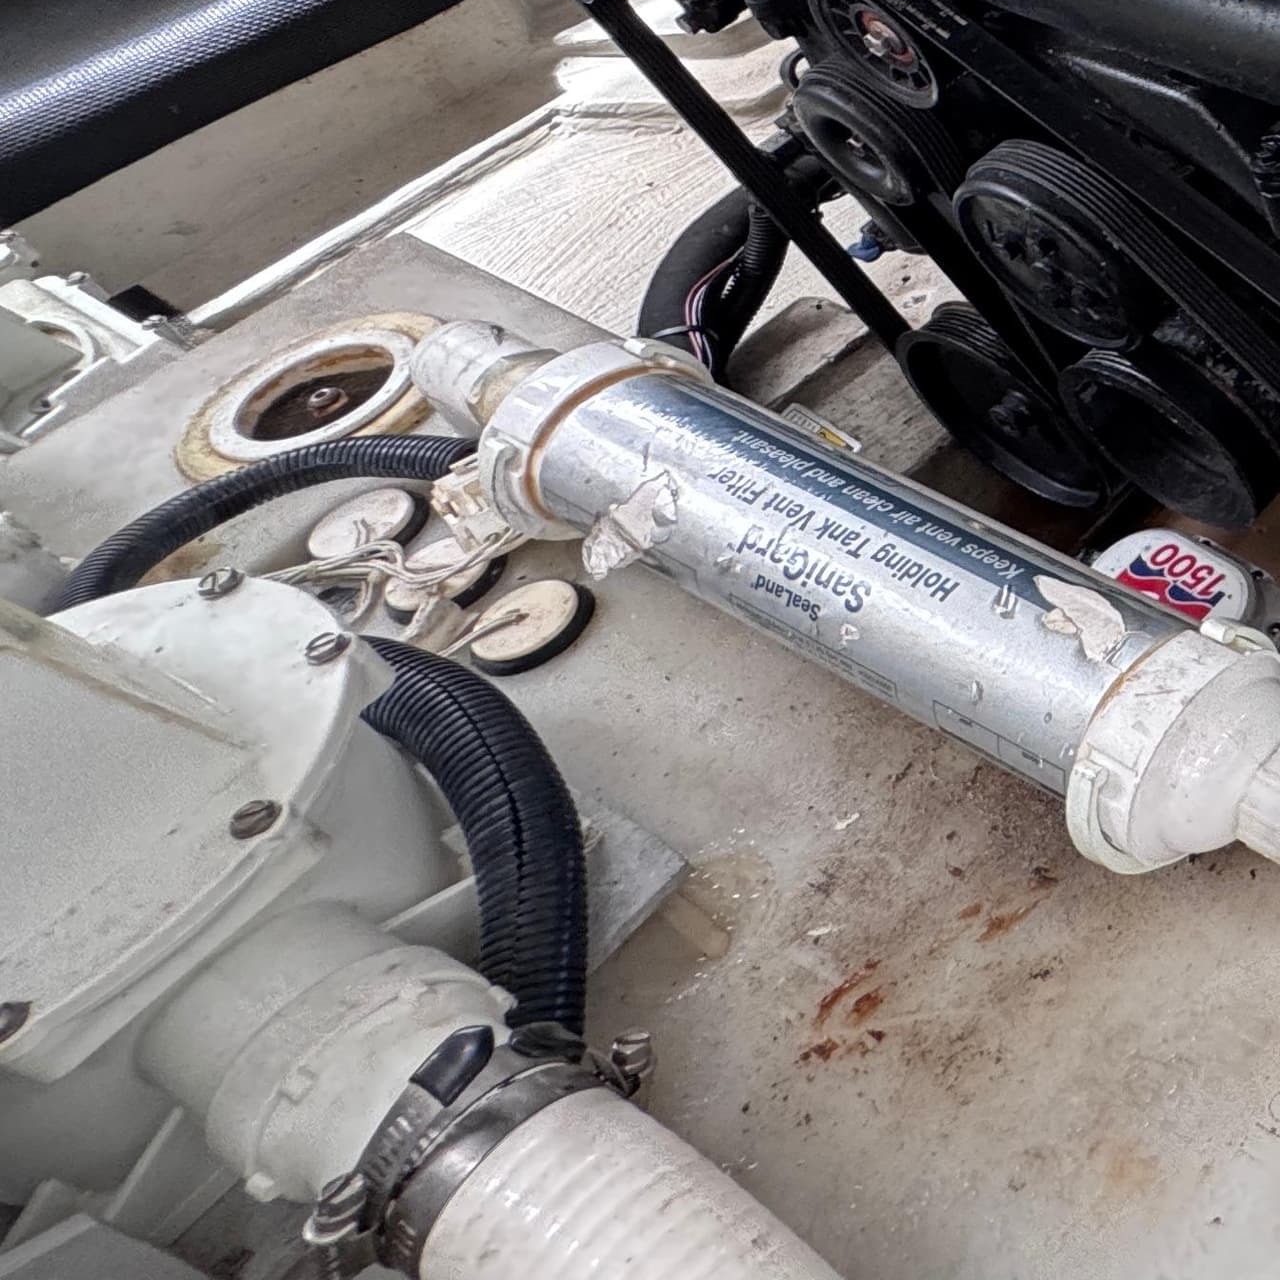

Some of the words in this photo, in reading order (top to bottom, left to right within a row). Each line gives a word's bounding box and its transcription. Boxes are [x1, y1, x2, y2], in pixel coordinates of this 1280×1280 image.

[708, 465, 773, 504] Filter
[807, 460, 845, 488] and
[762, 493, 818, 528] Vent
[842, 484, 893, 514] clean
[889, 509, 917, 527] air
[916, 521, 962, 545] vent
[814, 521, 872, 559] Tank
[870, 541, 961, 603] Holding
[960, 541, 1024, 580] Keeps
[1150, 544, 1226, 596] 1500
